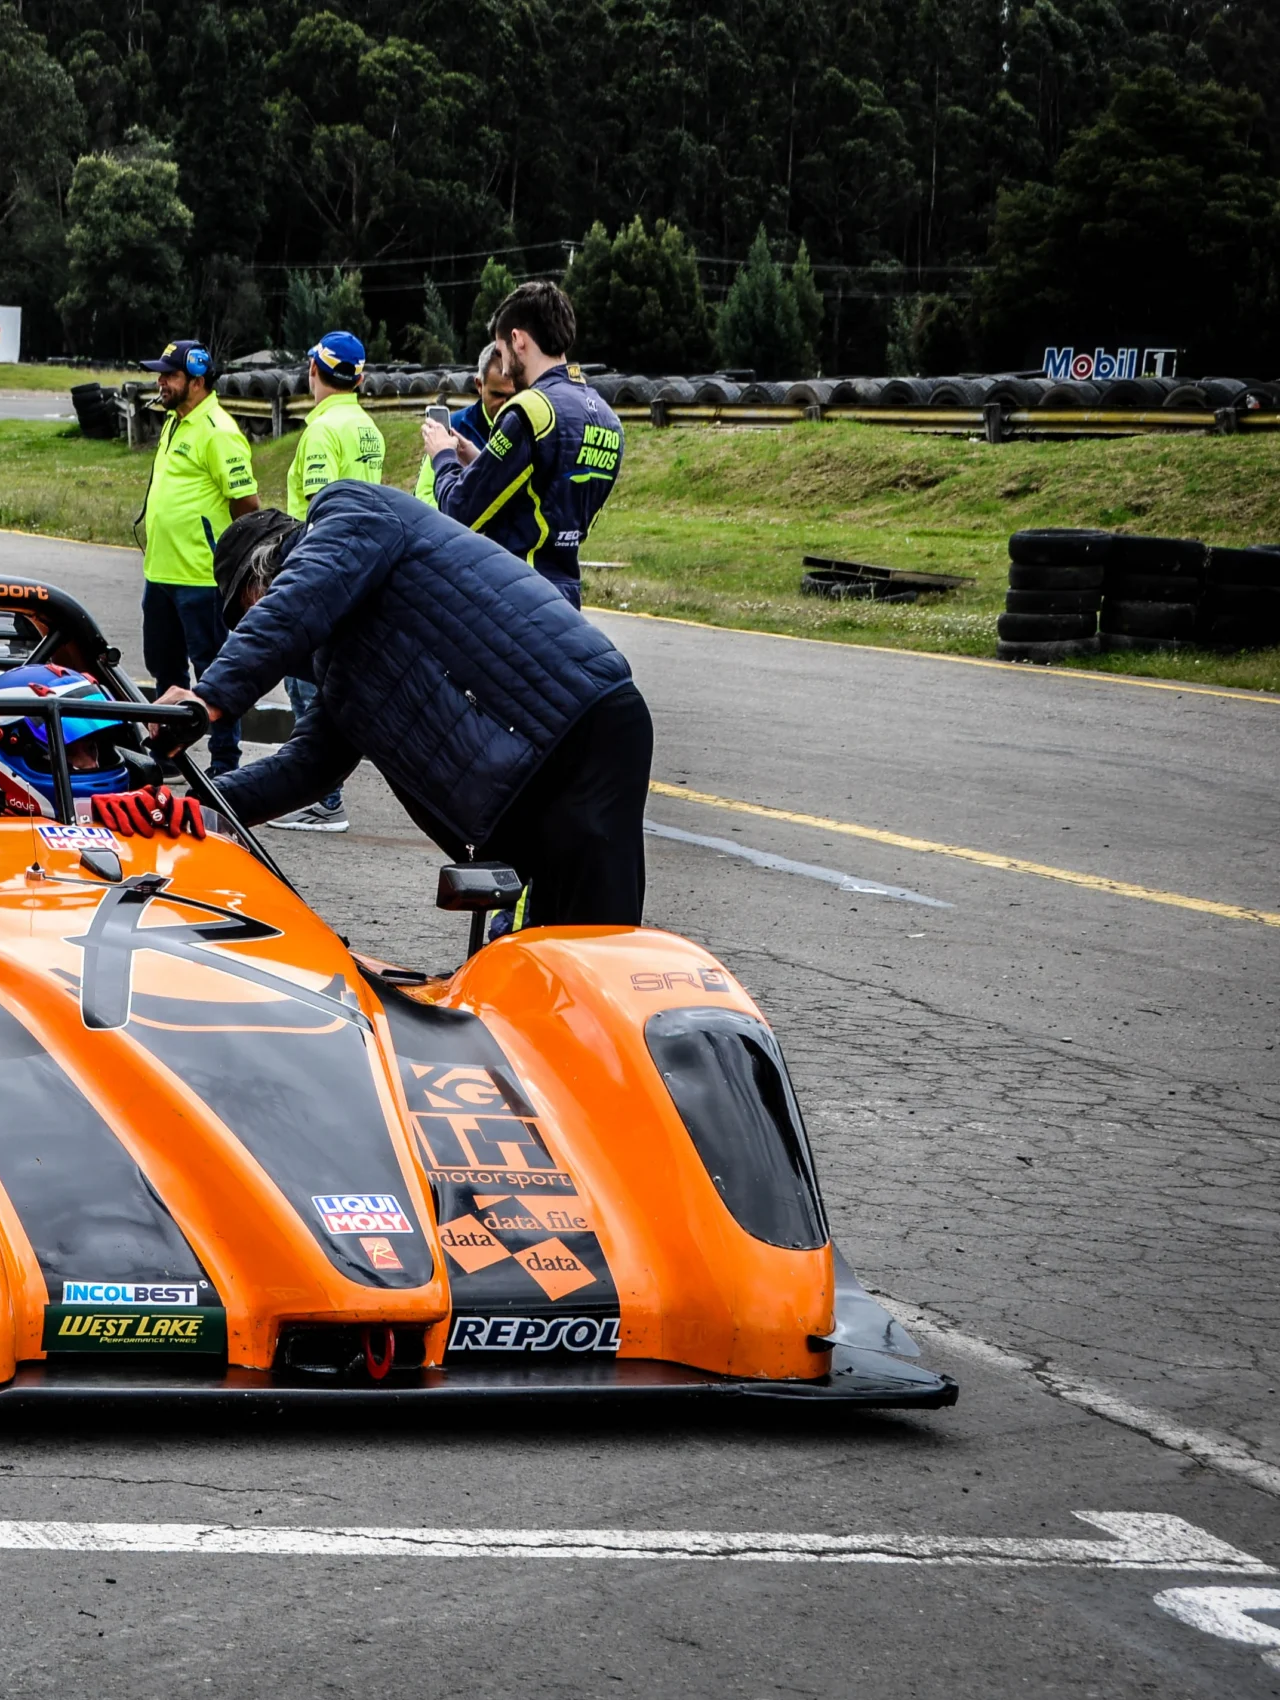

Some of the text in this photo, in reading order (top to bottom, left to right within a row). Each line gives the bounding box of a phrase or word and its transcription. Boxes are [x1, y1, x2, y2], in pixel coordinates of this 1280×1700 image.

[1042, 347, 1138, 380] Mobil
[44, 826, 112, 839] LIQUI
[51, 837, 119, 850] MOLY
[427, 1169, 572, 1189] motorsport
[318, 1196, 399, 1214] LIQUI
[328, 1214, 404, 1231] MOLY
[483, 1211, 588, 1230] data file
[440, 1228, 496, 1248] data
[526, 1252, 582, 1272] data
[65, 1284, 195, 1303] INCOLBEST
[58, 1314, 204, 1336] WEST LAKE
[451, 1317, 621, 1350] REPSOL
